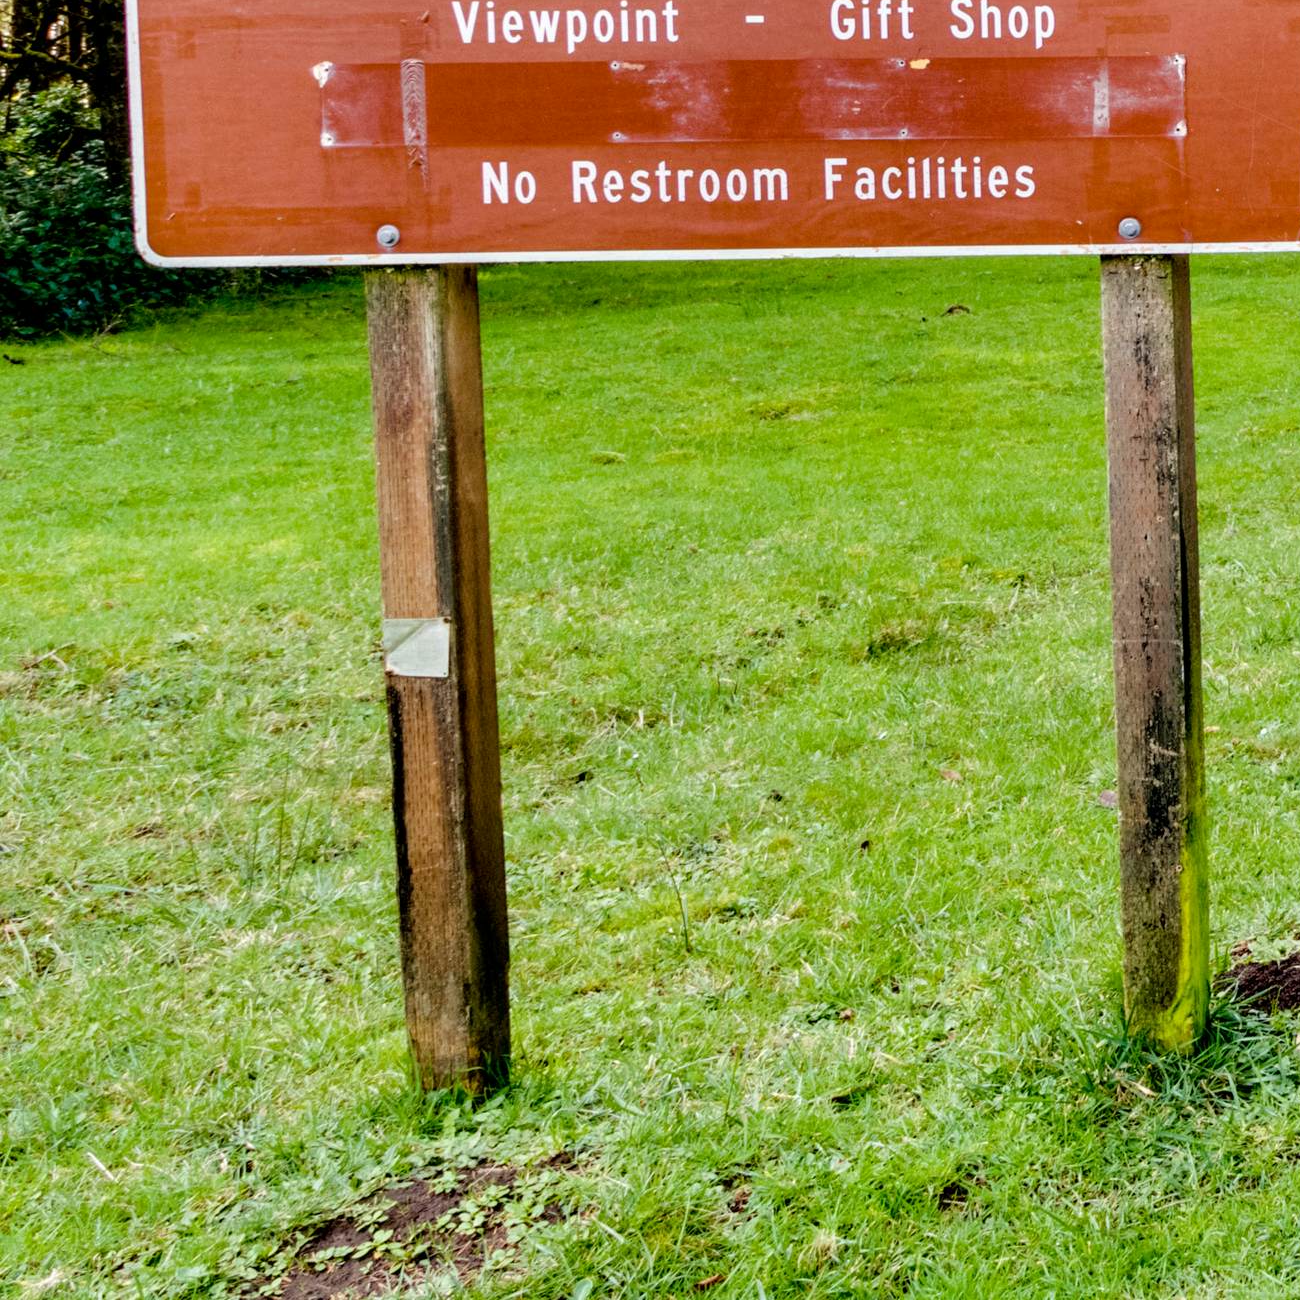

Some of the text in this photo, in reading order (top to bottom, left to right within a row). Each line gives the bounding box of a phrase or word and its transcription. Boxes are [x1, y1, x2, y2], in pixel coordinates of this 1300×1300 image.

[450, 0, 680, 53] Viewpoint
[481, 156, 1036, 205] No Restroom Facilities
